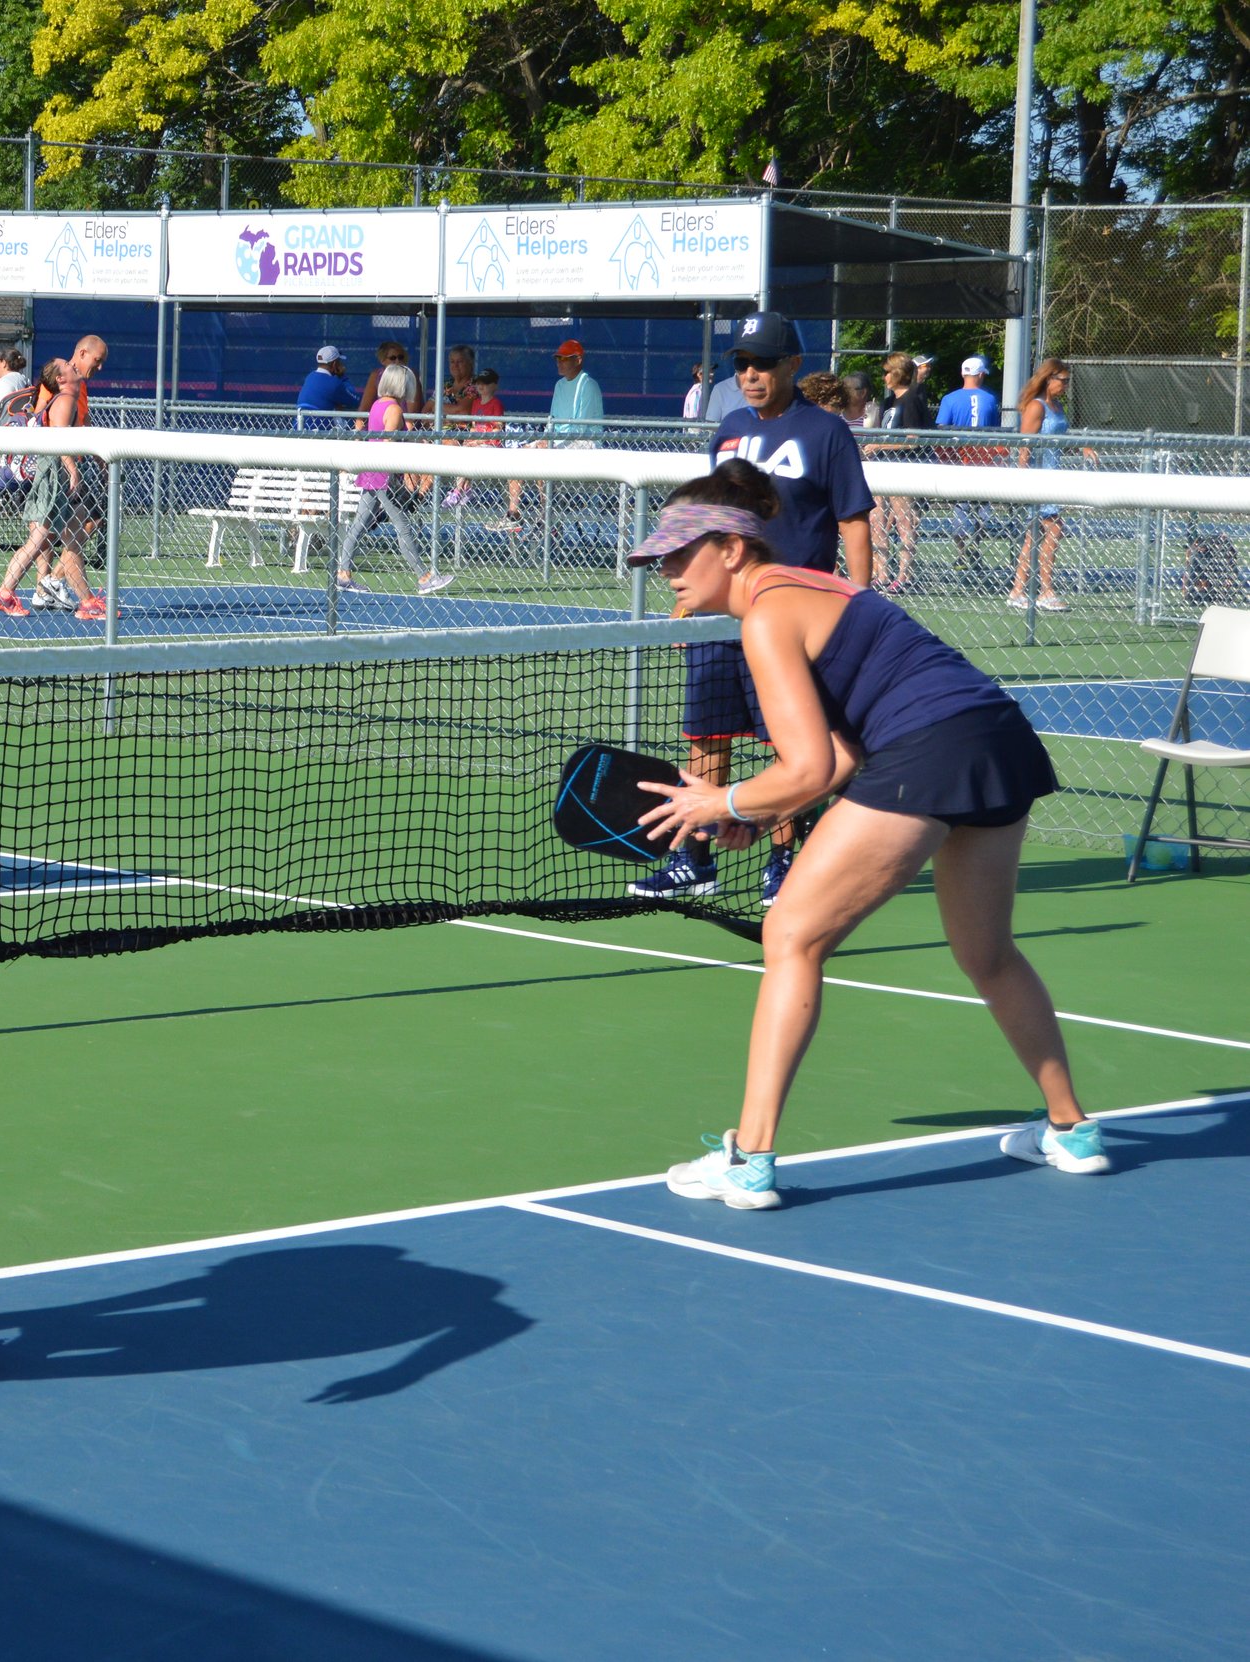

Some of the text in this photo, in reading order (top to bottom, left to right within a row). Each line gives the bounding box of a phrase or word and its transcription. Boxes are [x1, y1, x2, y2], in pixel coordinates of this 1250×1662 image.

[85, 221, 129, 239] Elders'
[505, 214, 558, 235] Elders'
[660, 210, 718, 232] Elders'
[284, 224, 365, 250] GRAND
[517, 235, 588, 260] Helpers
[672, 232, 749, 256] Helpers
[93, 240, 152, 261] Helpers
[283, 252, 364, 276] RAPIDS
[283, 277, 363, 287] PICKLEBALL CLUB
[741, 318, 759, 337] D
[970, 394, 979, 427] EAD
